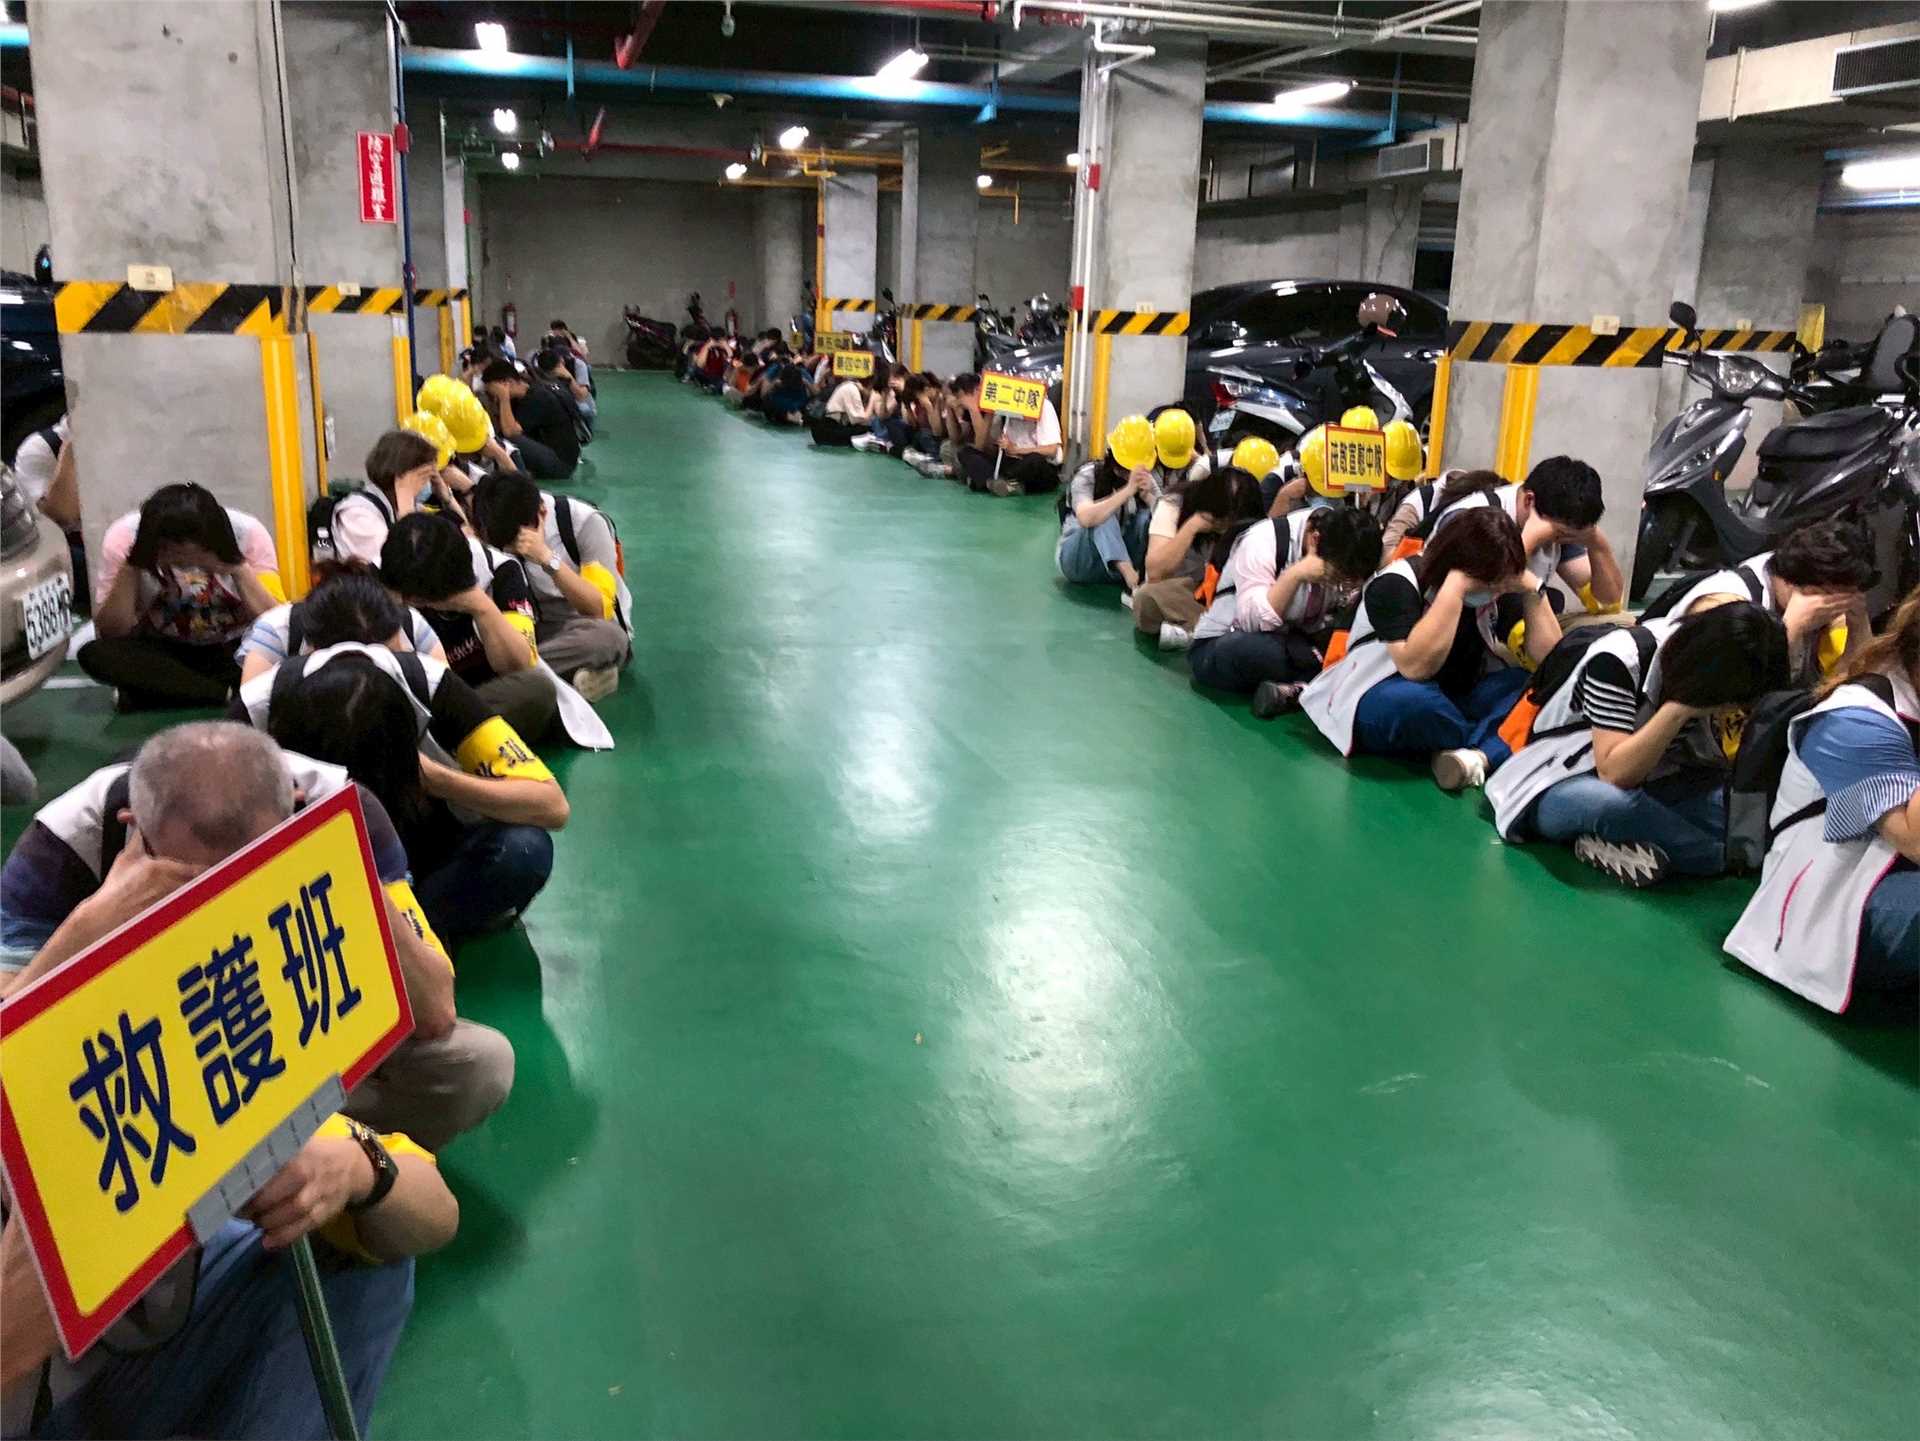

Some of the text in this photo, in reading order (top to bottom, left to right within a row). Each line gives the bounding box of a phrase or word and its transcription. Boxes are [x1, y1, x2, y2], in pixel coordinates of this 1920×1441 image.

[984, 381, 1041, 411] 第二中隊
[69, 872, 362, 1213] 救護班
